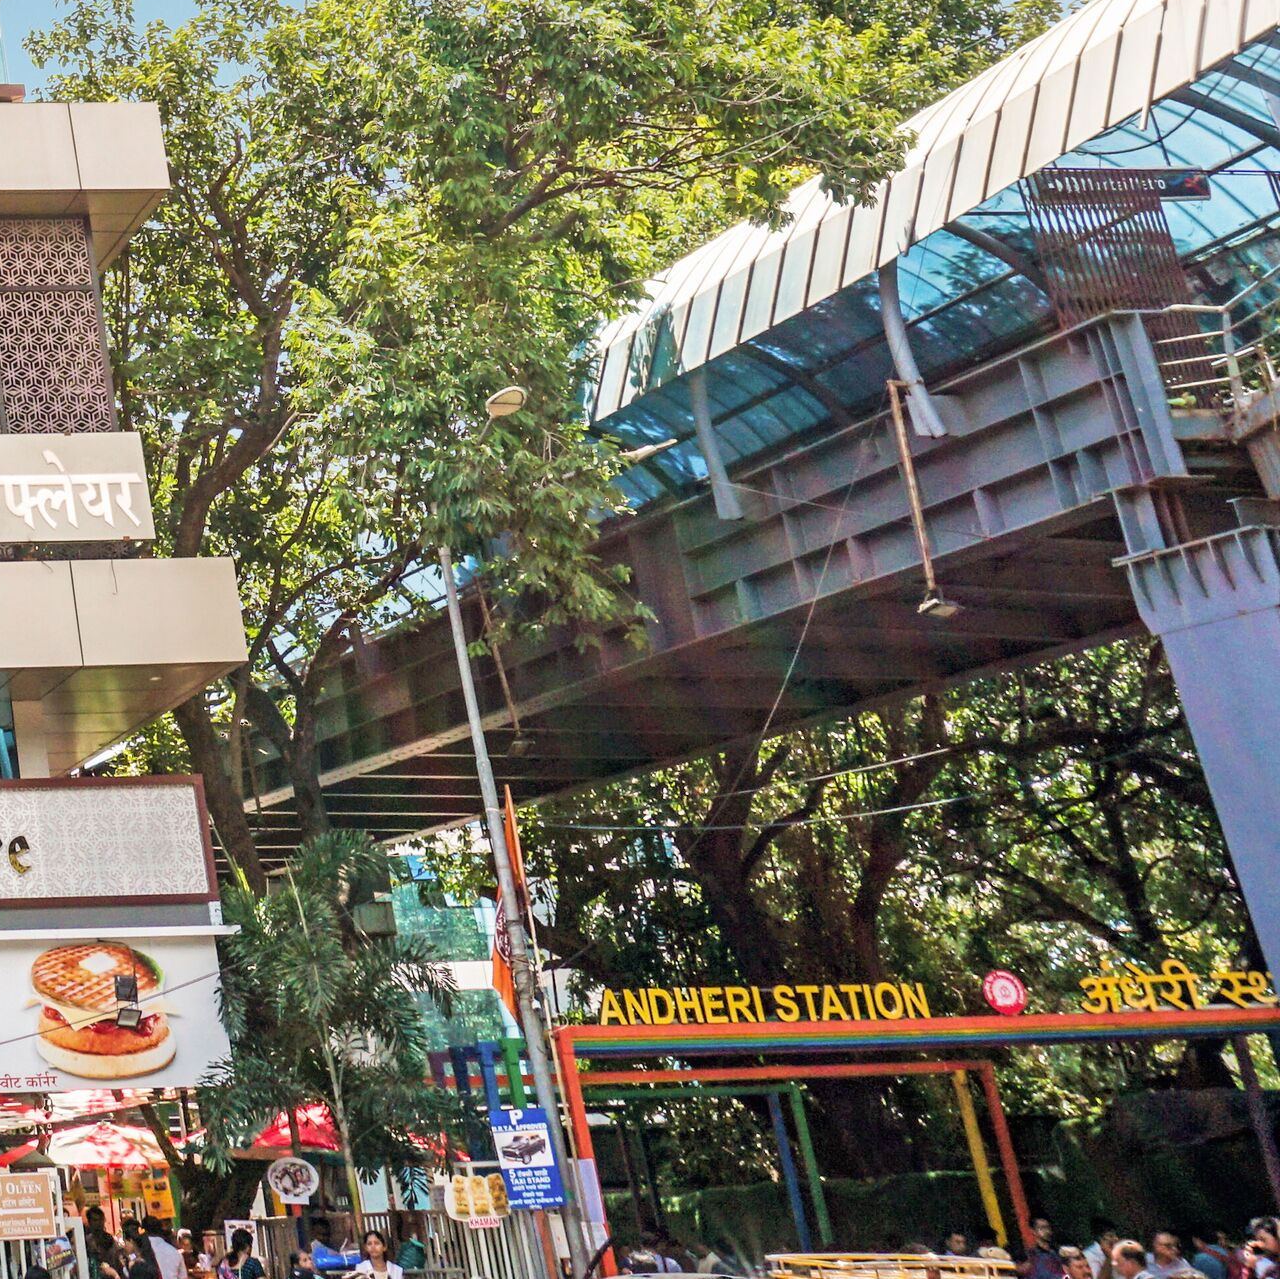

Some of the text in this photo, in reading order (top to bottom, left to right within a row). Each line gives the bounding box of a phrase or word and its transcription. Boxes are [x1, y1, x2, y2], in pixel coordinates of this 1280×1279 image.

[600, 981, 931, 1025] ANDHERI STATION
[1079, 959, 1200, 1015] अंधेरी
[6, 1182, 42, 1195] OLTEN
